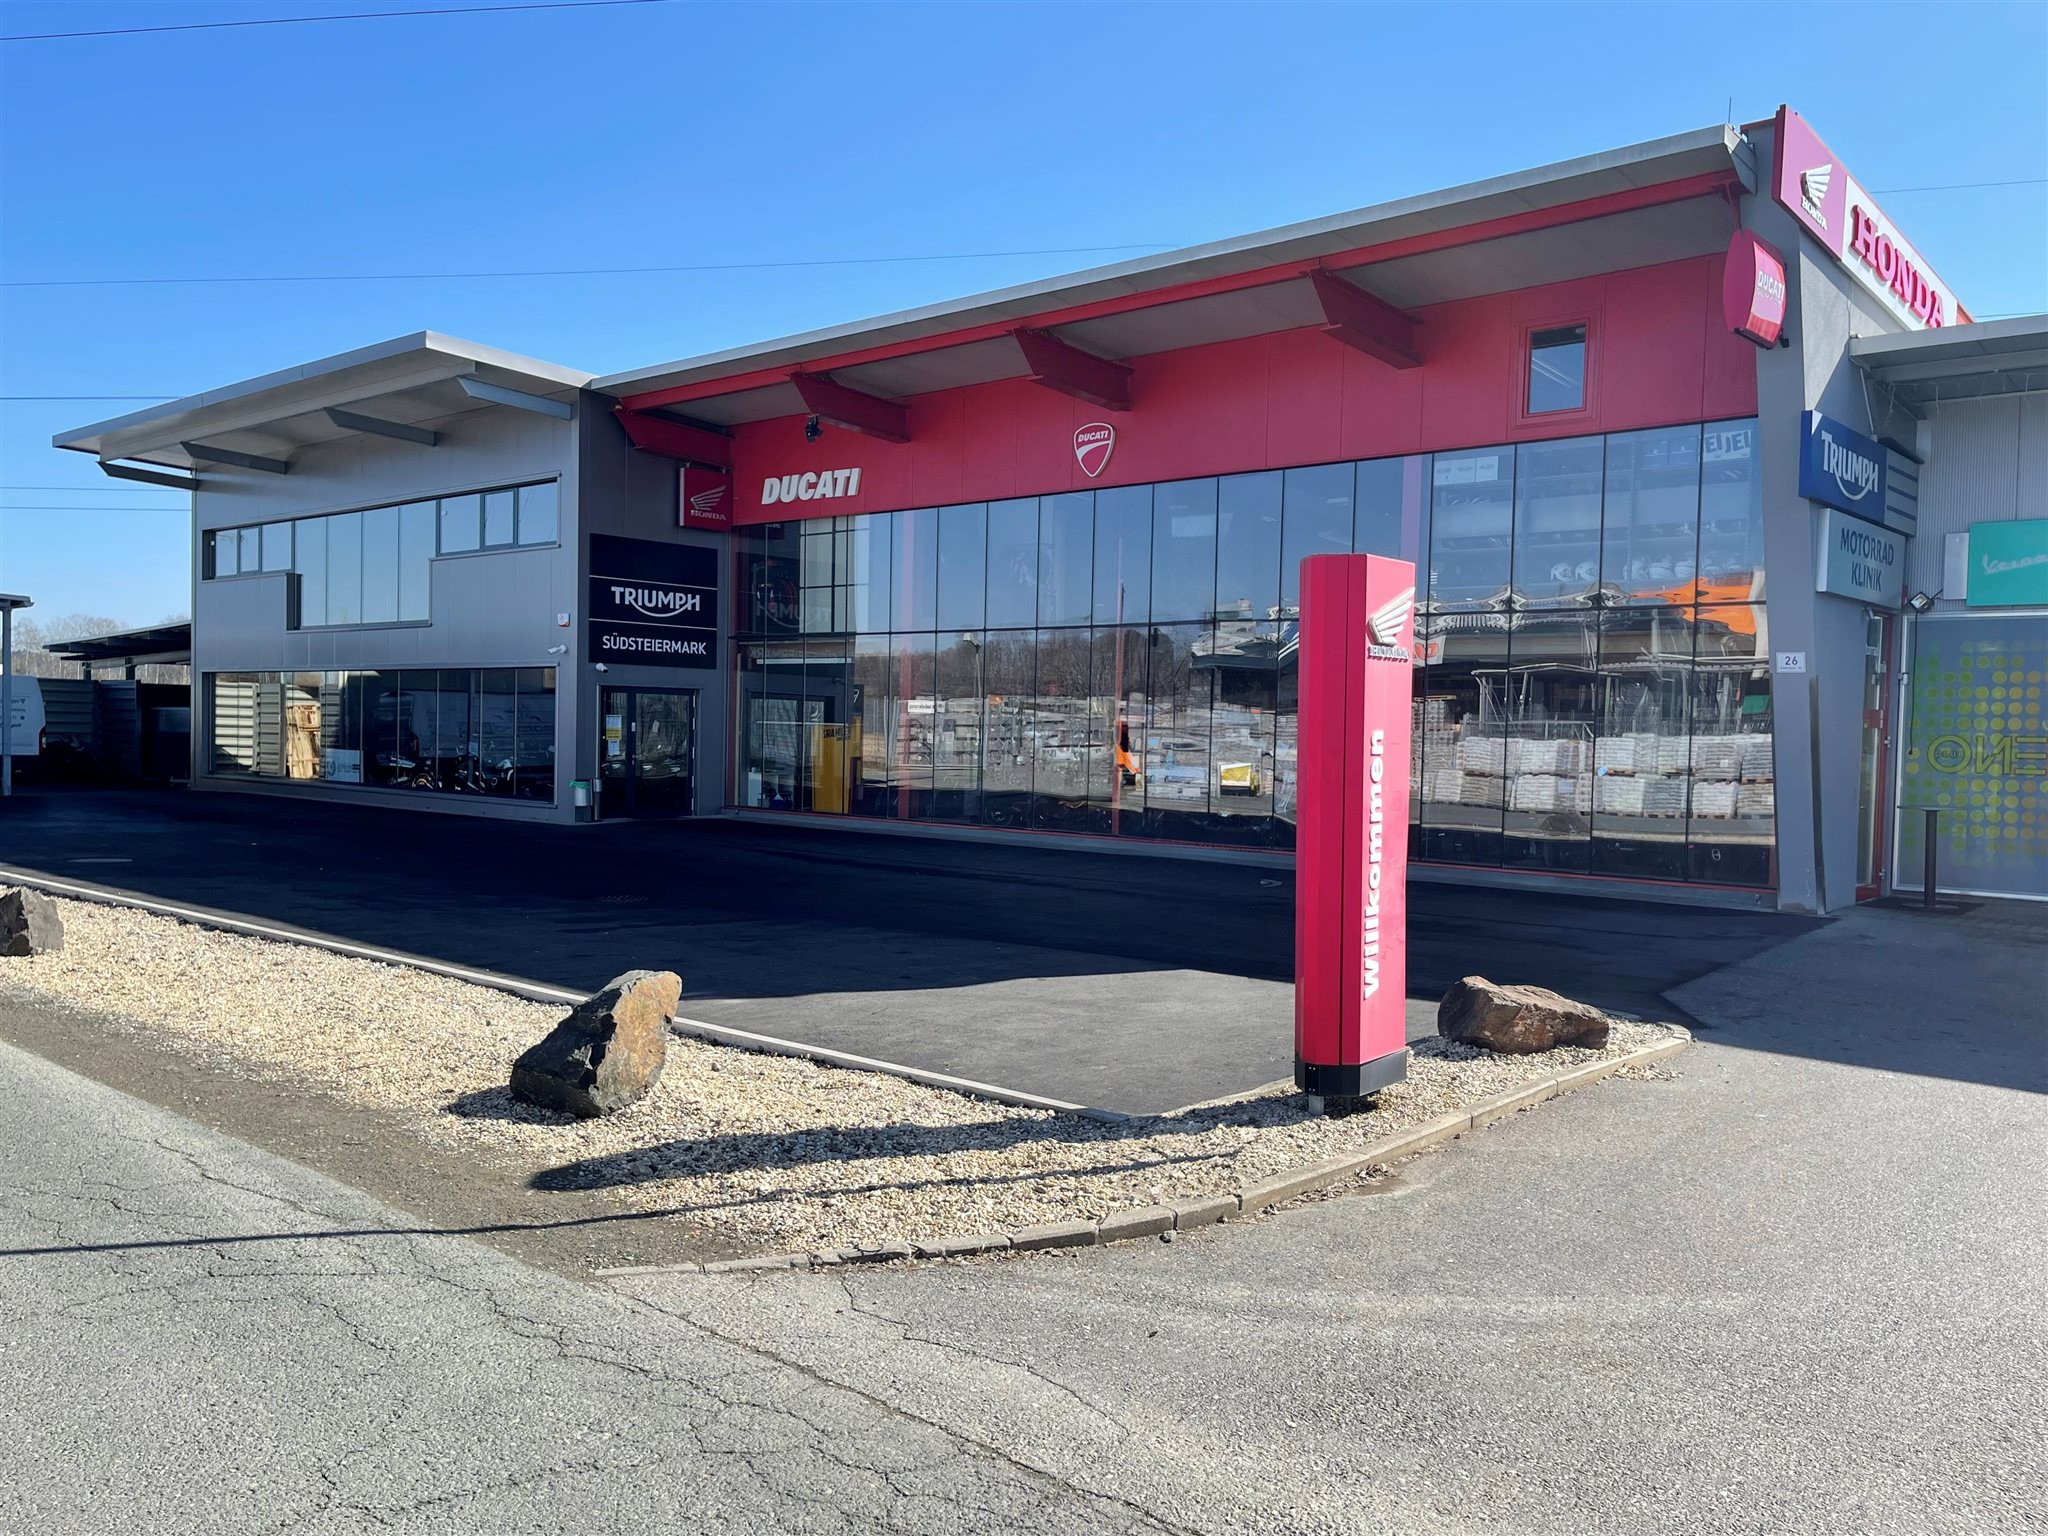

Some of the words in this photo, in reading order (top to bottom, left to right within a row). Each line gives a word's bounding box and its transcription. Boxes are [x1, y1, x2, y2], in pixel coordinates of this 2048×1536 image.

[1801, 196, 1827, 231] HONDA
[1849, 204, 1944, 328] HONDA
[1757, 270, 1785, 301] DUCATI
[1078, 431, 1108, 442] DUCATI
[1821, 430, 1879, 501] TRIUMPH
[761, 467, 862, 505] DUCATI
[689, 509, 727, 522] HONDA
[1840, 527, 1895, 567] MOTORRAD
[1851, 561, 1882, 592] KLINIK
[611, 585, 701, 618] TRIUMPH
[602, 633, 707, 655] SÜDSTEIERMARK
[1368, 645, 1411, 661] HONDA
[1784, 655, 1798, 666] 26
